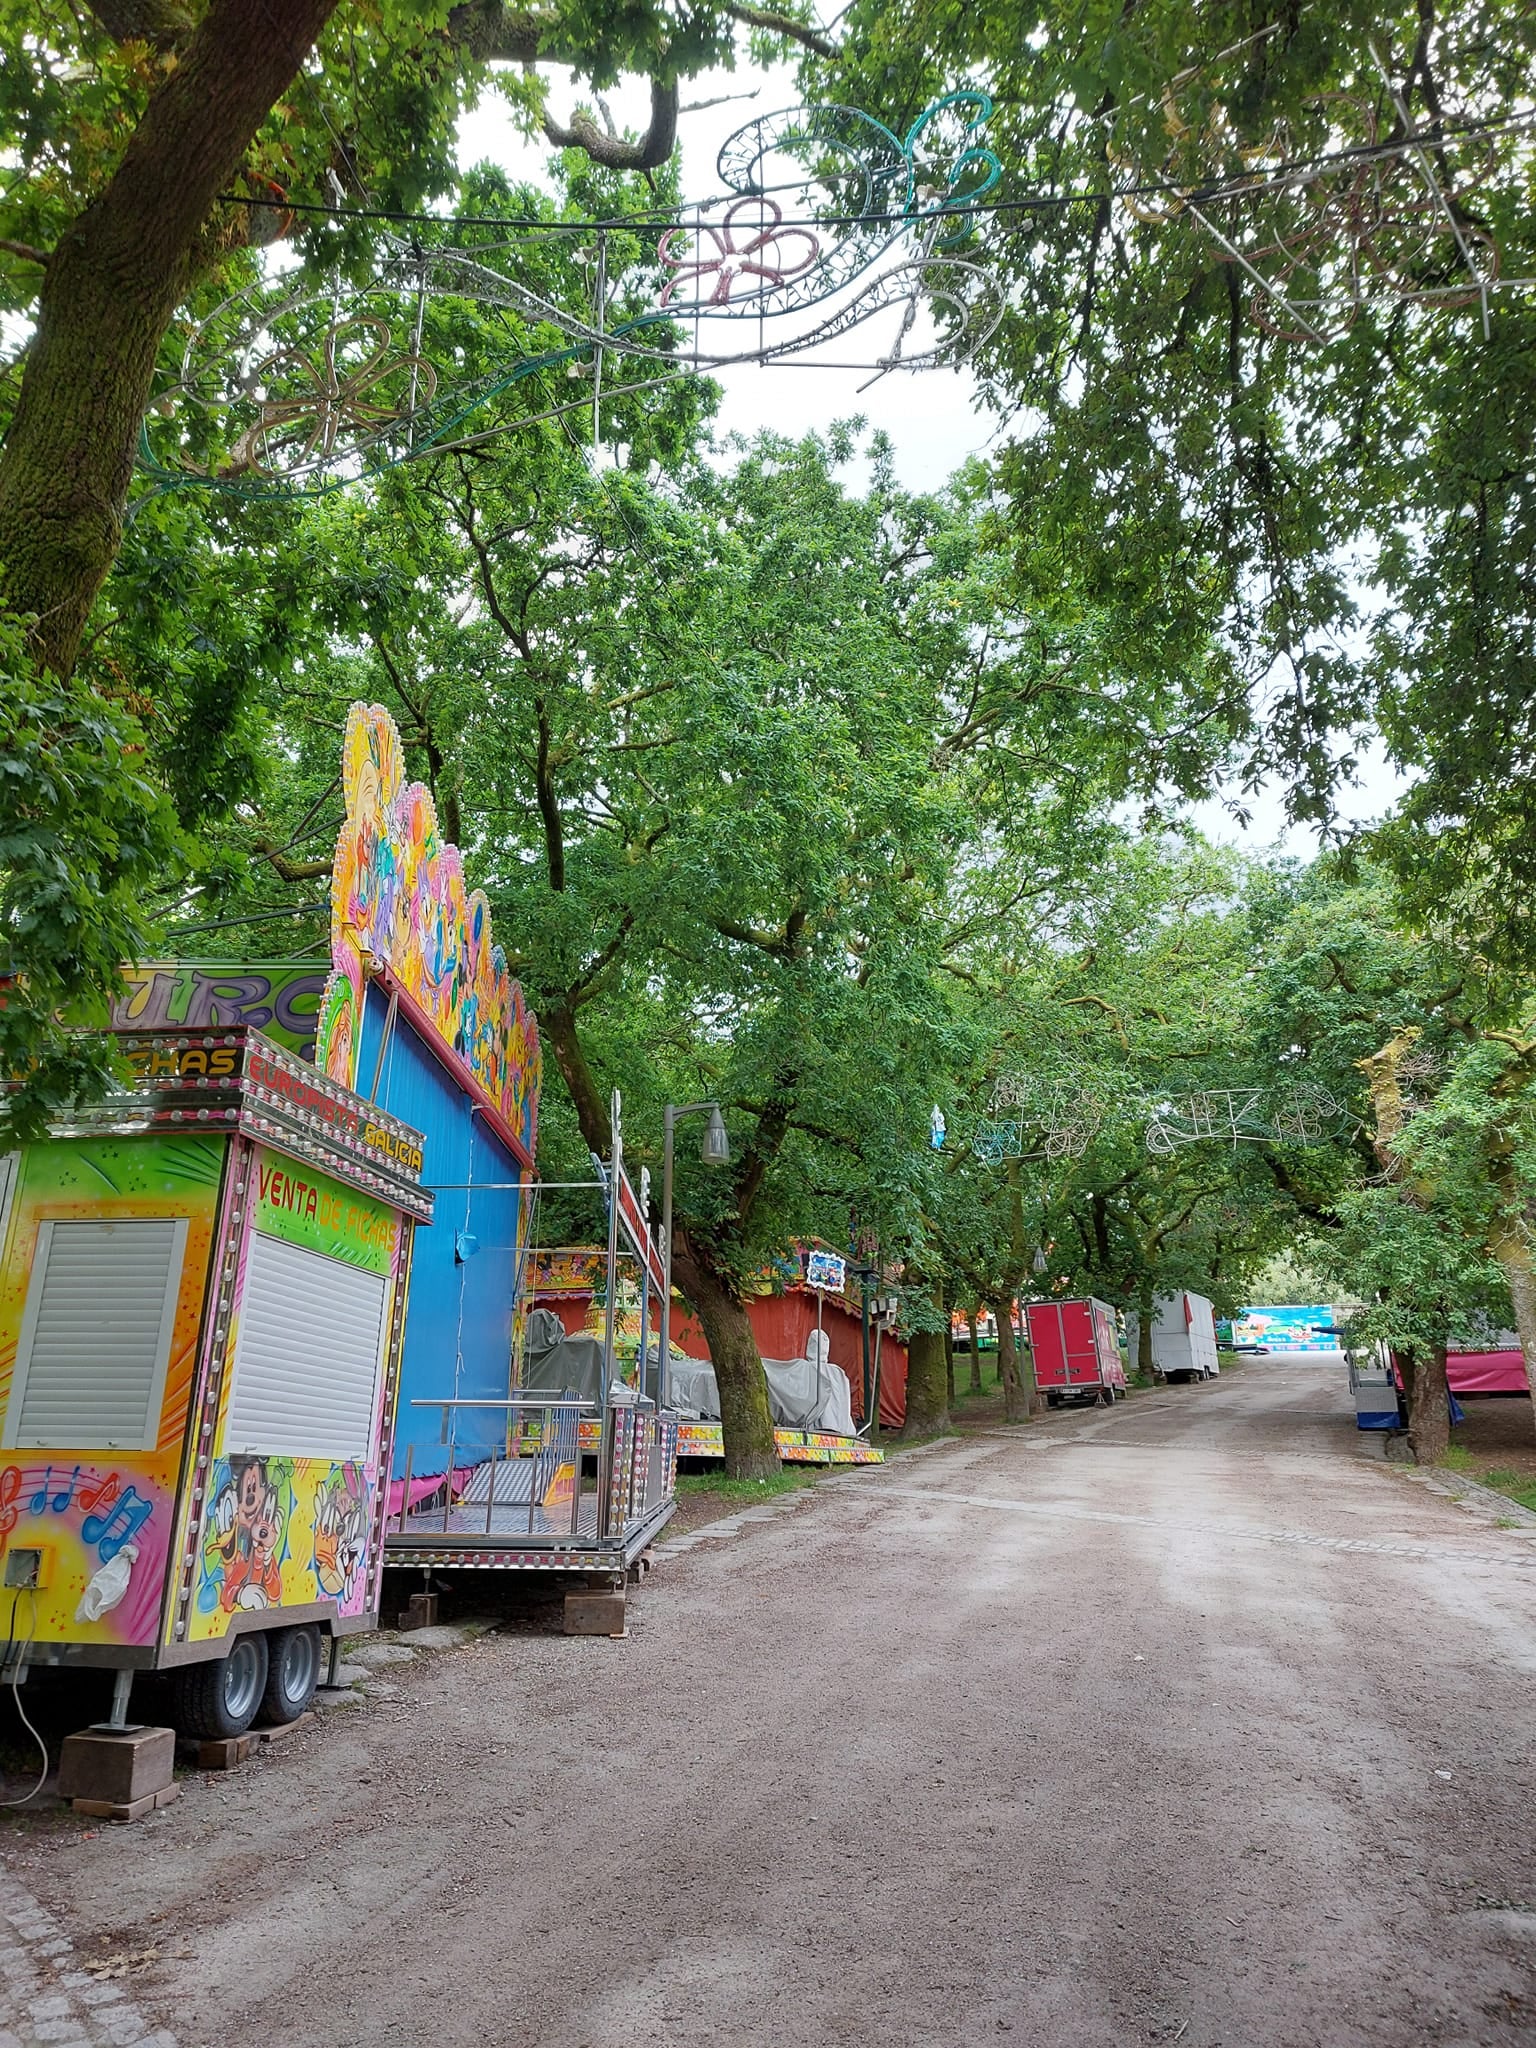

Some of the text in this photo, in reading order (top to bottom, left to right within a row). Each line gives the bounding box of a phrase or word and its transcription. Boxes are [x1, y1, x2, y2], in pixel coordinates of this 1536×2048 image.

[249, 1055, 422, 1172] EUROPISTA GALICIA
[259, 1164, 397, 1252] VENTA DE FICHAS
